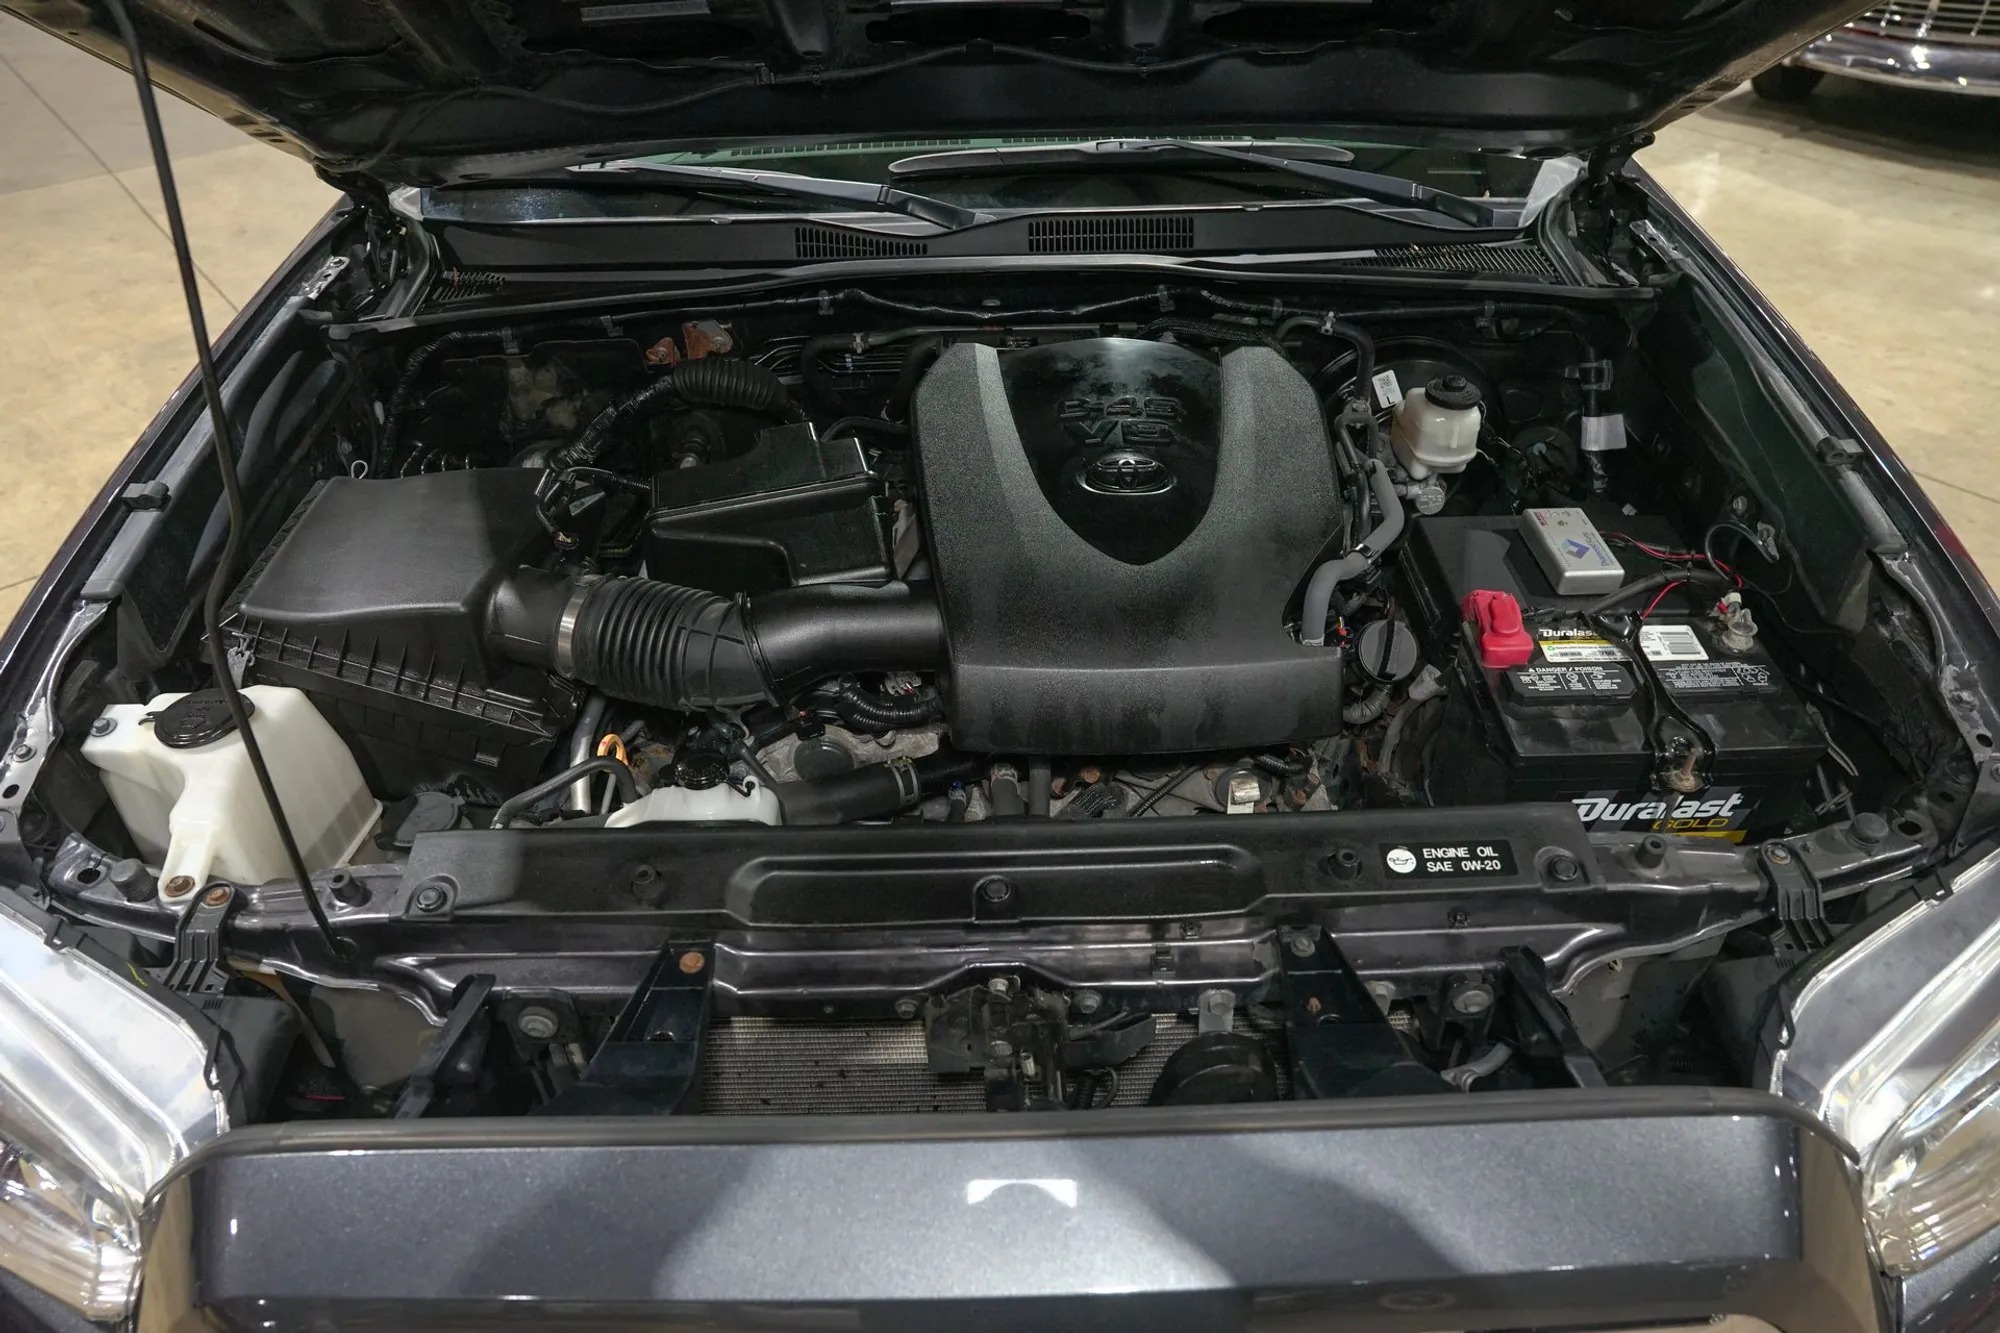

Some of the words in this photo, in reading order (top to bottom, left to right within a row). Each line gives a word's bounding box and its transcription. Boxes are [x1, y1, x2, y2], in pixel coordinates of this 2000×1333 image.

[1386, 396, 1396, 405] L
[1422, 846, 1470, 858] ENGINE
[1476, 846, 1499, 857] OIL
[1426, 861, 1454, 872] SAE
[1461, 859, 1501, 871] 0W-20
